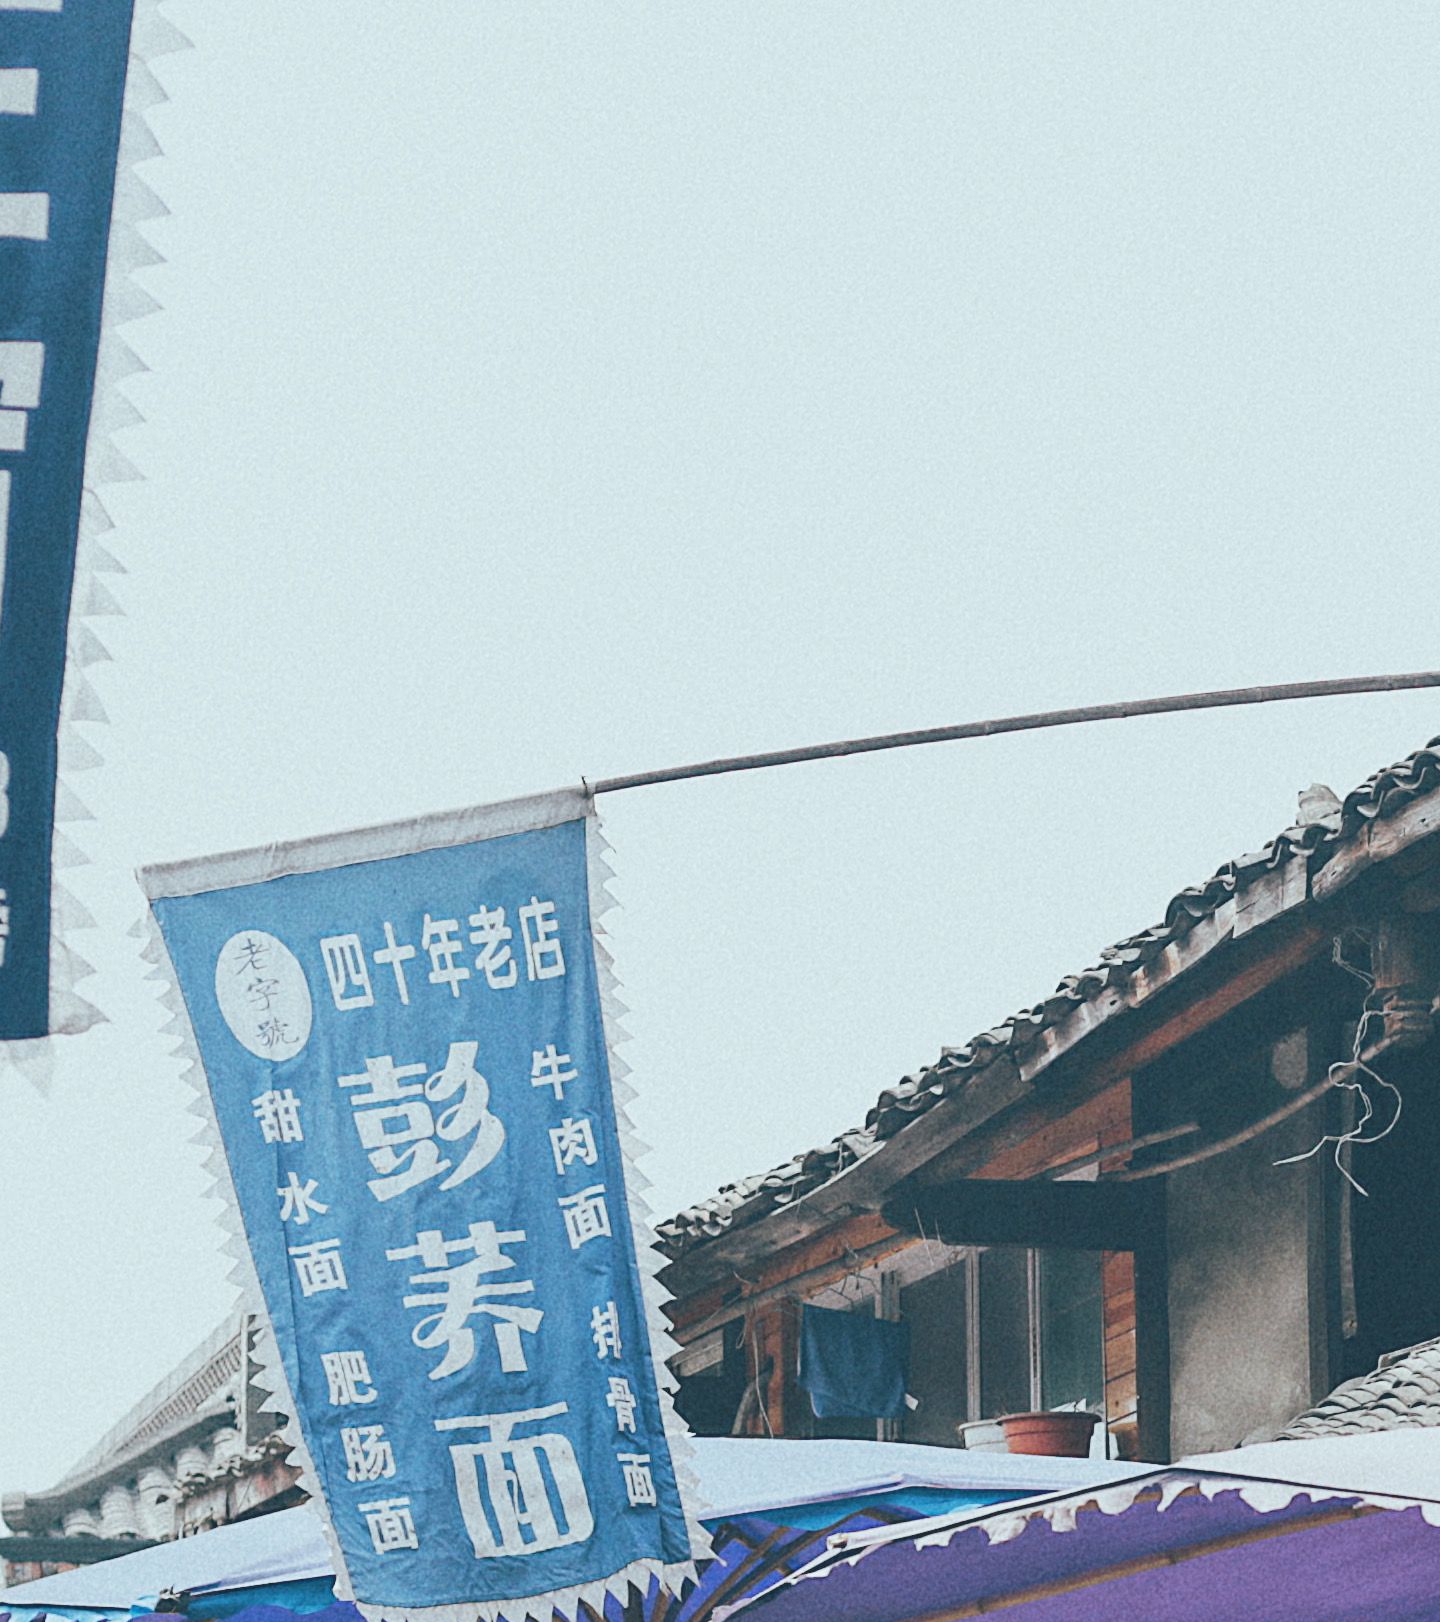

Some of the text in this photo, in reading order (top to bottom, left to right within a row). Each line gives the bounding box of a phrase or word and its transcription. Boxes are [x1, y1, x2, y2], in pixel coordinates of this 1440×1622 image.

[320, 896, 566, 1011] 四十年老店
[336, 1041, 596, 1561] 彭荞面
[530, 1044, 613, 1250] 牛肉面
[252, 1088, 420, 1554] 甜水面 肥肠面
